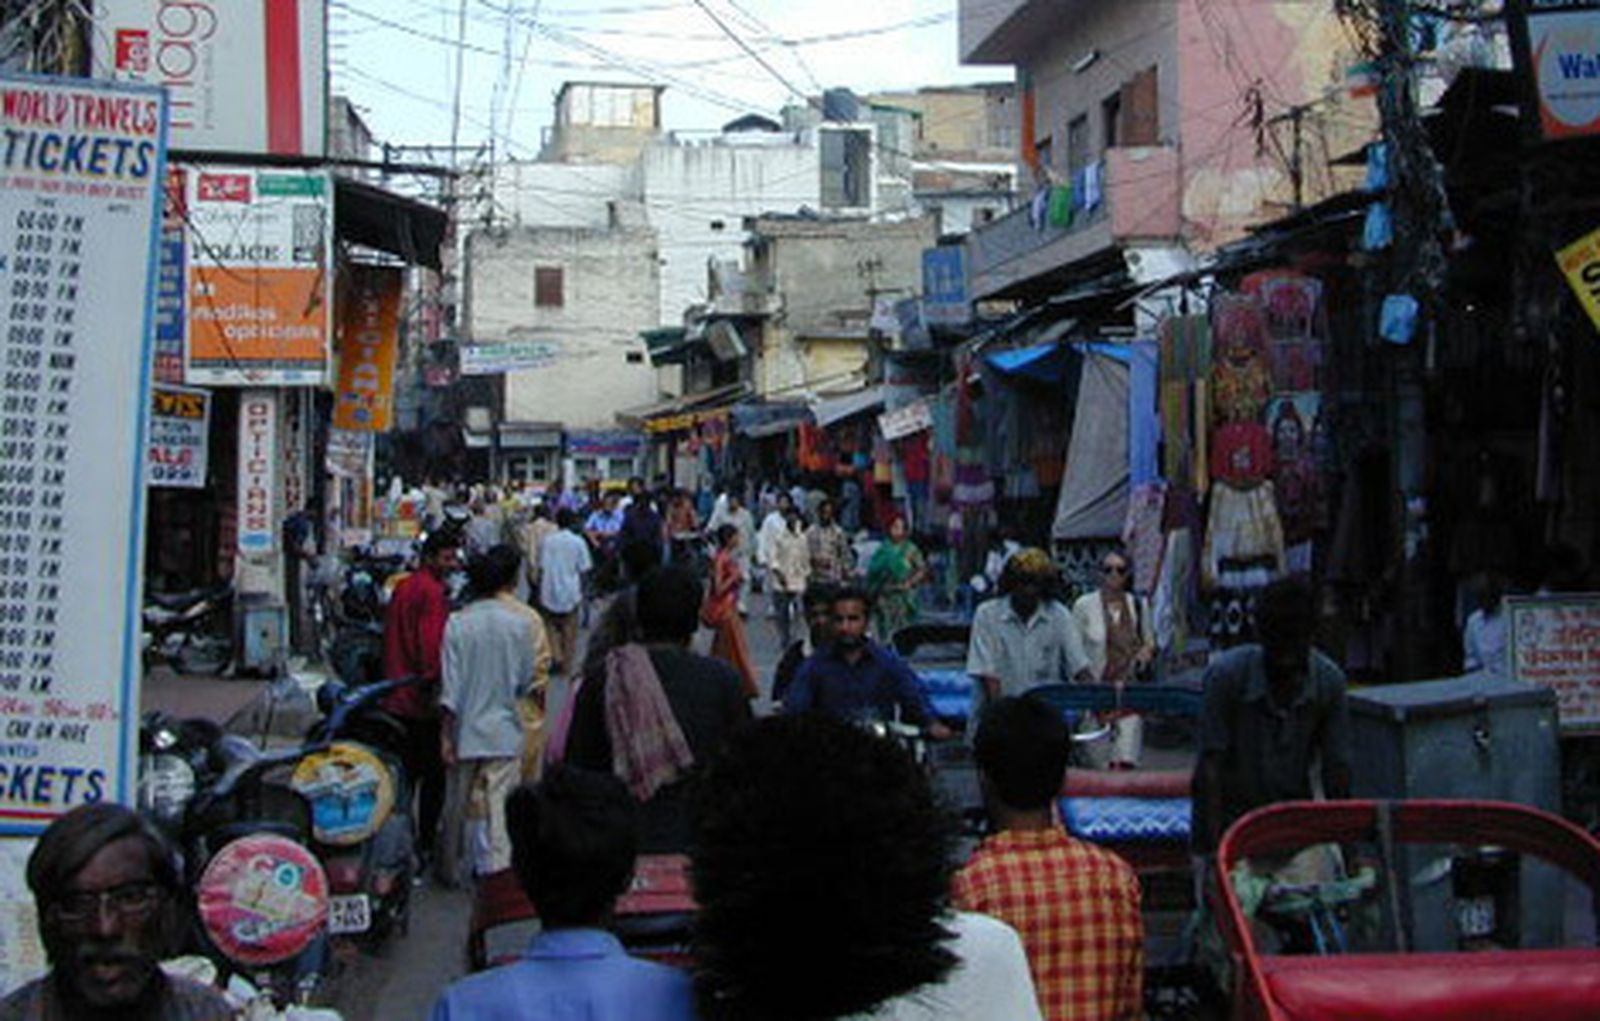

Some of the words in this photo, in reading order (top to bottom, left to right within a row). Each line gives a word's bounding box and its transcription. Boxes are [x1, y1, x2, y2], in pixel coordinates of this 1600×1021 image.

[3, 89, 68, 125] WORLD
[71, 92, 157, 135] TRAVELS
[4, 127, 155, 178] TICKETS
[247, 403, 267, 531] OPTICIANS
